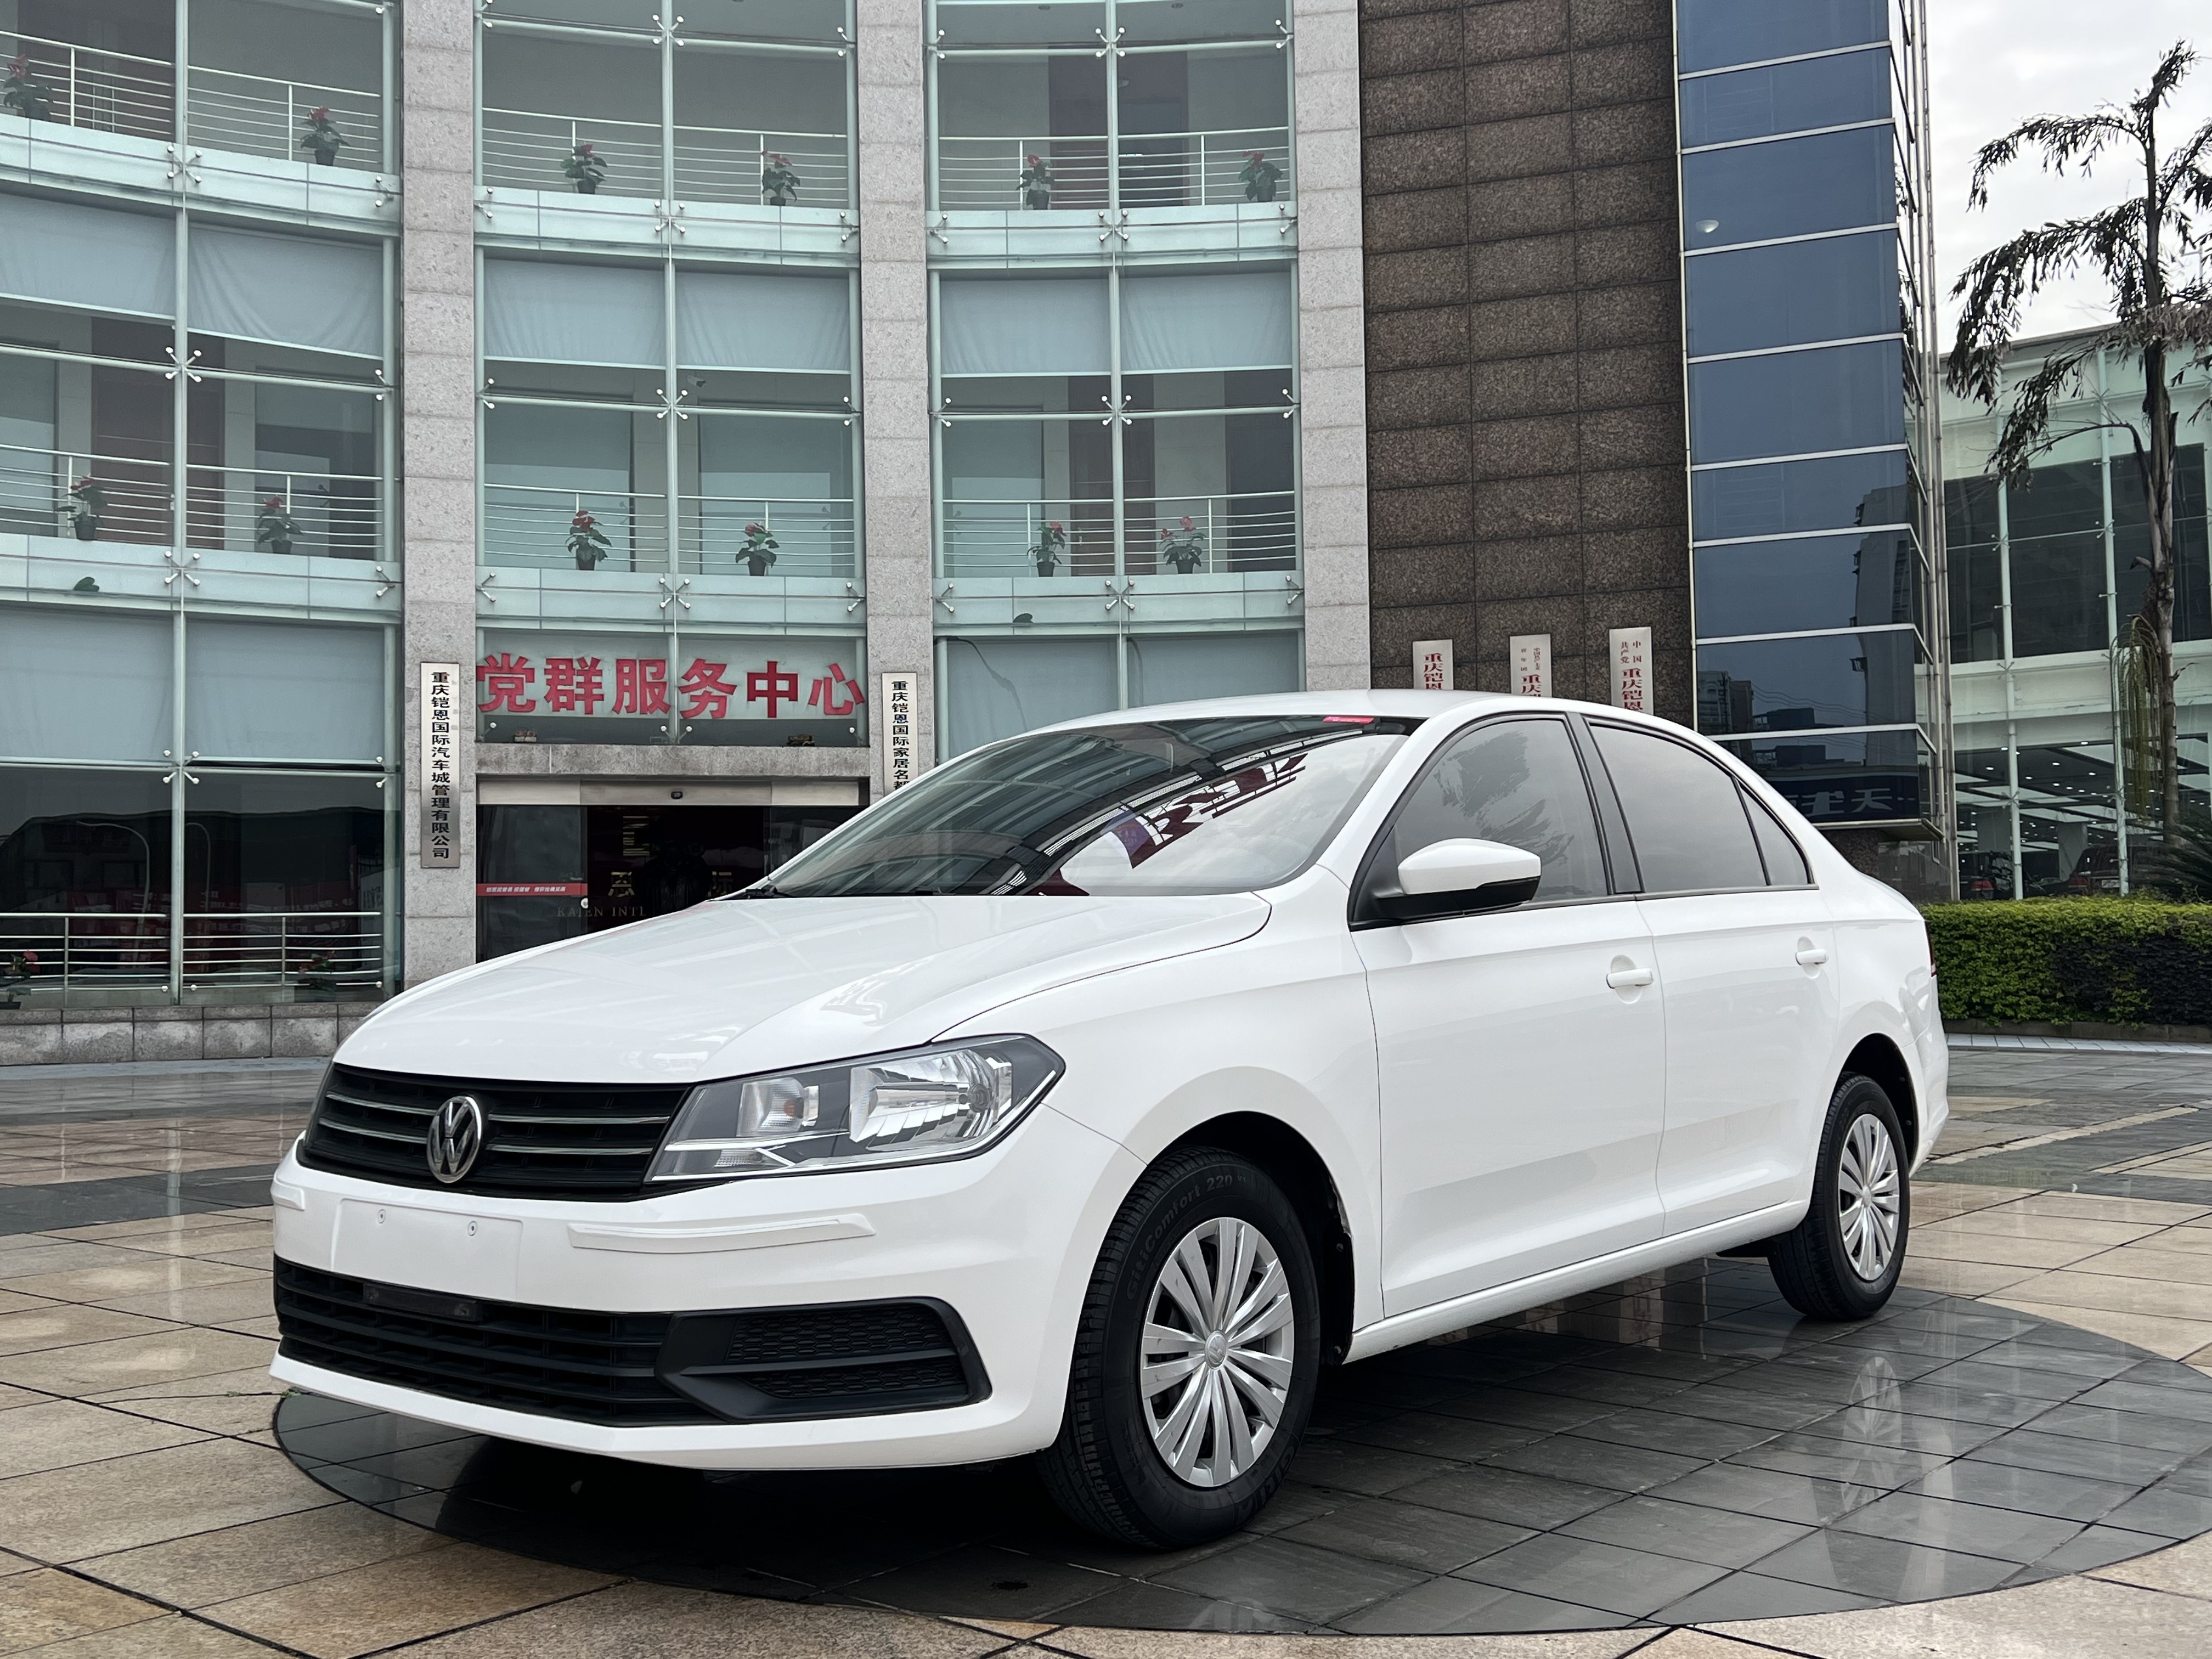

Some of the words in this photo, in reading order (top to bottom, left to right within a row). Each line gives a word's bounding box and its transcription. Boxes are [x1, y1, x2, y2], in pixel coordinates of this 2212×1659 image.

[476, 653, 866, 719] 党群服务中心
[431, 672, 451, 859] 重庆铠恩国际汽车城管理有限公司
[1206, 1174, 1233, 1192] 220
